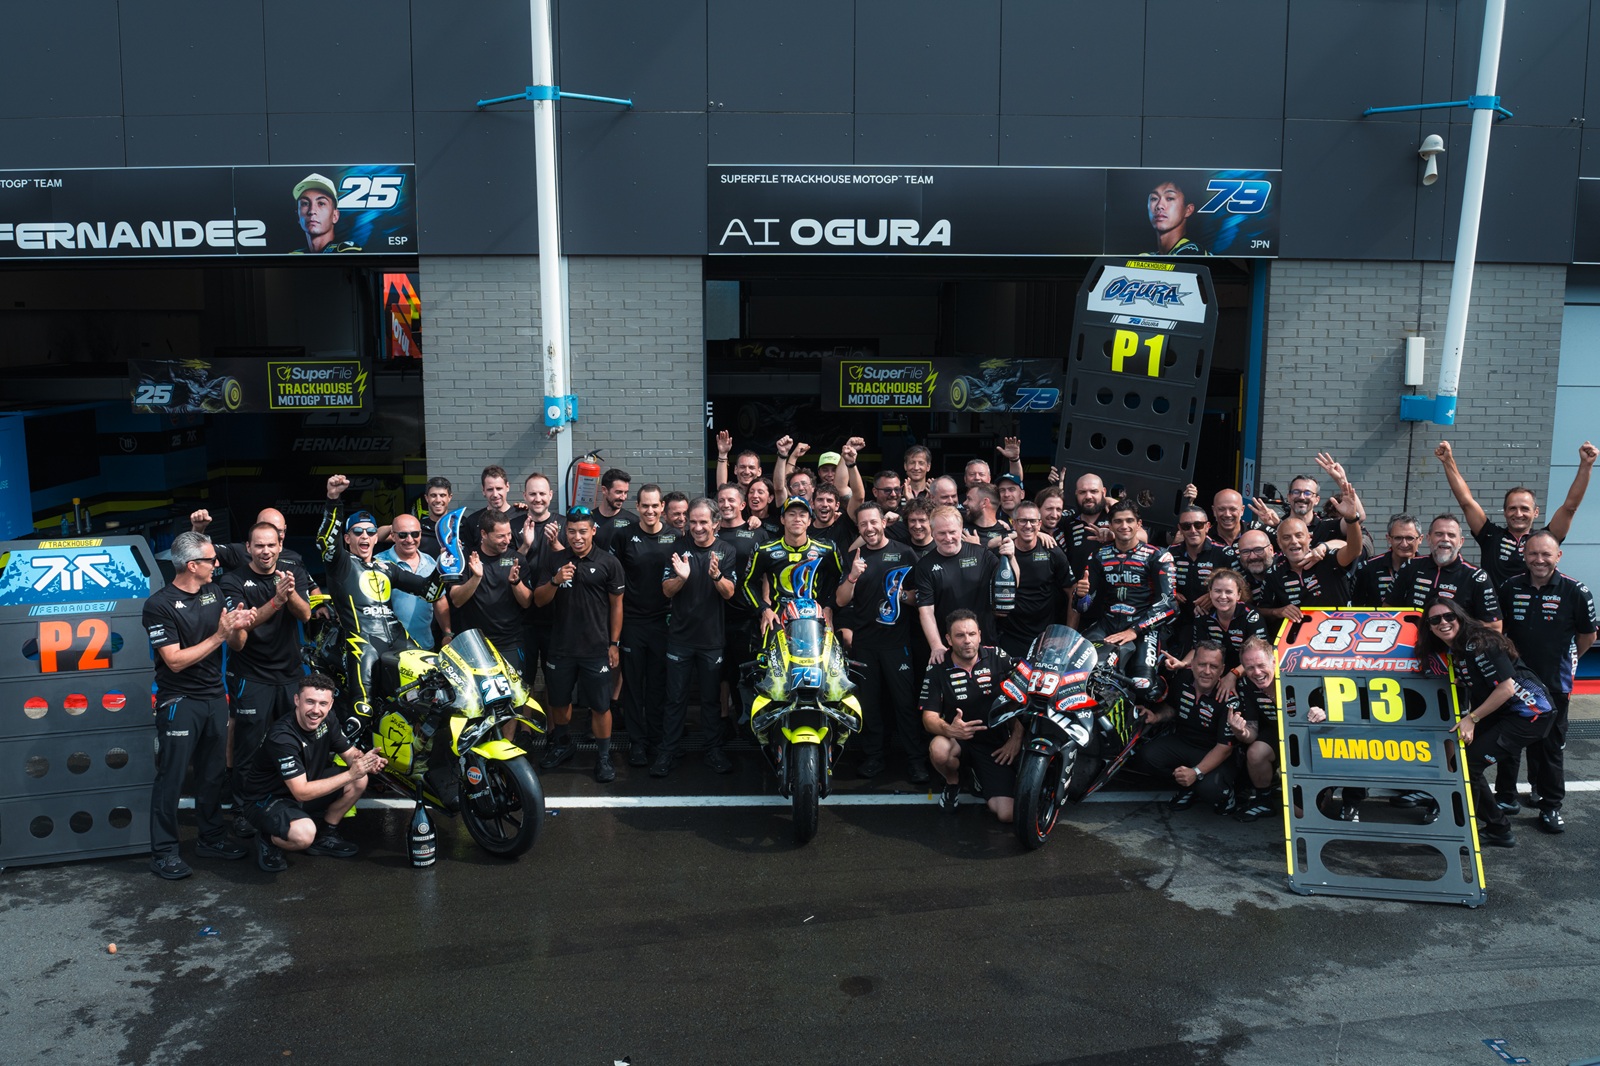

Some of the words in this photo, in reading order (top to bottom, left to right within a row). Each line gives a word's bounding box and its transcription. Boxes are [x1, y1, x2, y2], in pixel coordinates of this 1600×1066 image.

[33, 179, 63, 188] TEAM
[719, 174, 779, 184] SUPERFILE
[780, 174, 851, 184] TRACKHOUSE
[904, 175, 934, 185] TEAM
[337, 175, 404, 210] 25
[1197, 179, 1272, 213] 79
[719, 218, 779, 246] AI
[790, 218, 951, 246] OGURA
[388, 236, 408, 246] ESP
[1250, 240, 1271, 249] JPN
[1133, 262, 1168, 270] TRACKHOUSE
[1101, 275, 1186, 308] OGURA
[1127, 317, 1142, 325] 79
[1111, 329, 1165, 377] P1
[136, 384, 174, 405] 25
[277, 382, 353, 395] TRACKHOUSE
[848, 382, 923, 394] TRACKHOUSE
[278, 394, 320, 406] MOTOGP
[323, 394, 354, 406] TEAM
[848, 393, 890, 405] MOTOGP
[893, 393, 923, 405] TEAM
[1010, 387, 1060, 410] 79
[291, 435, 393, 451] FERNÁNDEZ
[1245, 462, 1253, 481] 11
[47, 539, 94, 548] TRACKHOUSE
[1105, 571, 1141, 585] aprilia
[1308, 618, 1402, 653] 89
[39, 618, 111, 673] P2
[1144, 630, 1158, 668] aprilia
[1300, 656, 1421, 672] MARTINATOR
[791, 667, 823, 691] 79
[1028, 669, 1060, 696] 89
[481, 675, 512, 706] 25
[1317, 738, 1432, 762] VAMOOOS
[467, 771, 482, 780] Gulf
